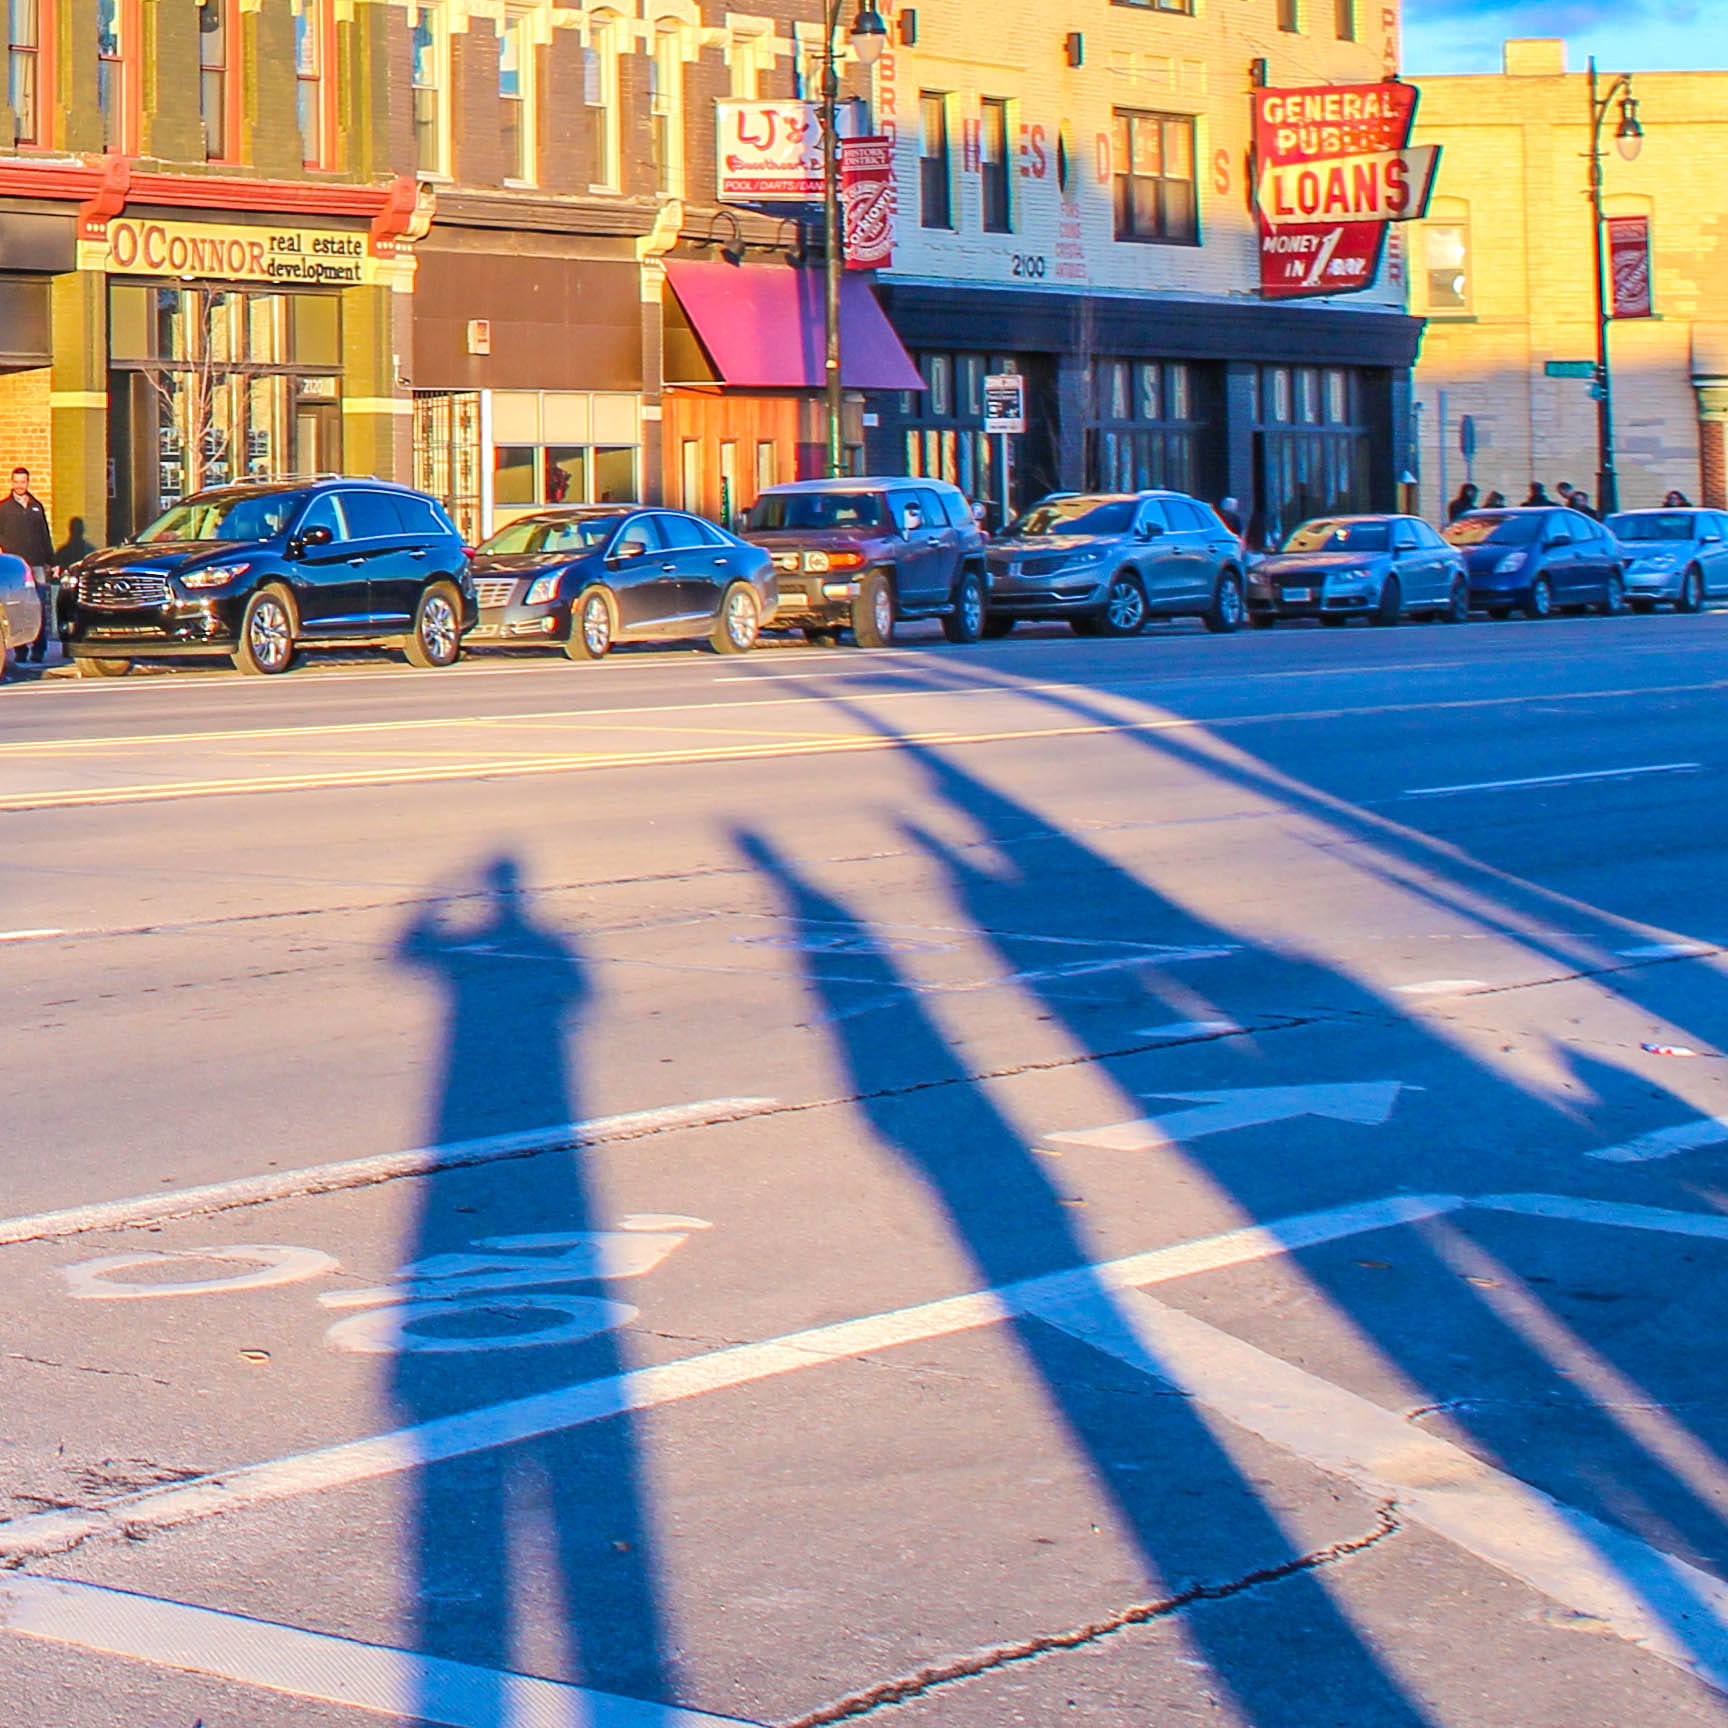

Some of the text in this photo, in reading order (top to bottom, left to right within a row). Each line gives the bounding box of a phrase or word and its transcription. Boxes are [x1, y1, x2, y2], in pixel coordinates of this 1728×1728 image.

[1263, 92, 1399, 123] GENERAL
[1273, 158, 1410, 216] LOANS
[111, 221, 267, 274] O'CONNOR
[269, 234, 363, 256] real estate
[1263, 235, 1321, 253] MONEY
[266, 257, 362, 284] development
[1011, 254, 1045, 278] 2100
[1285, 260, 1305, 277] IN
